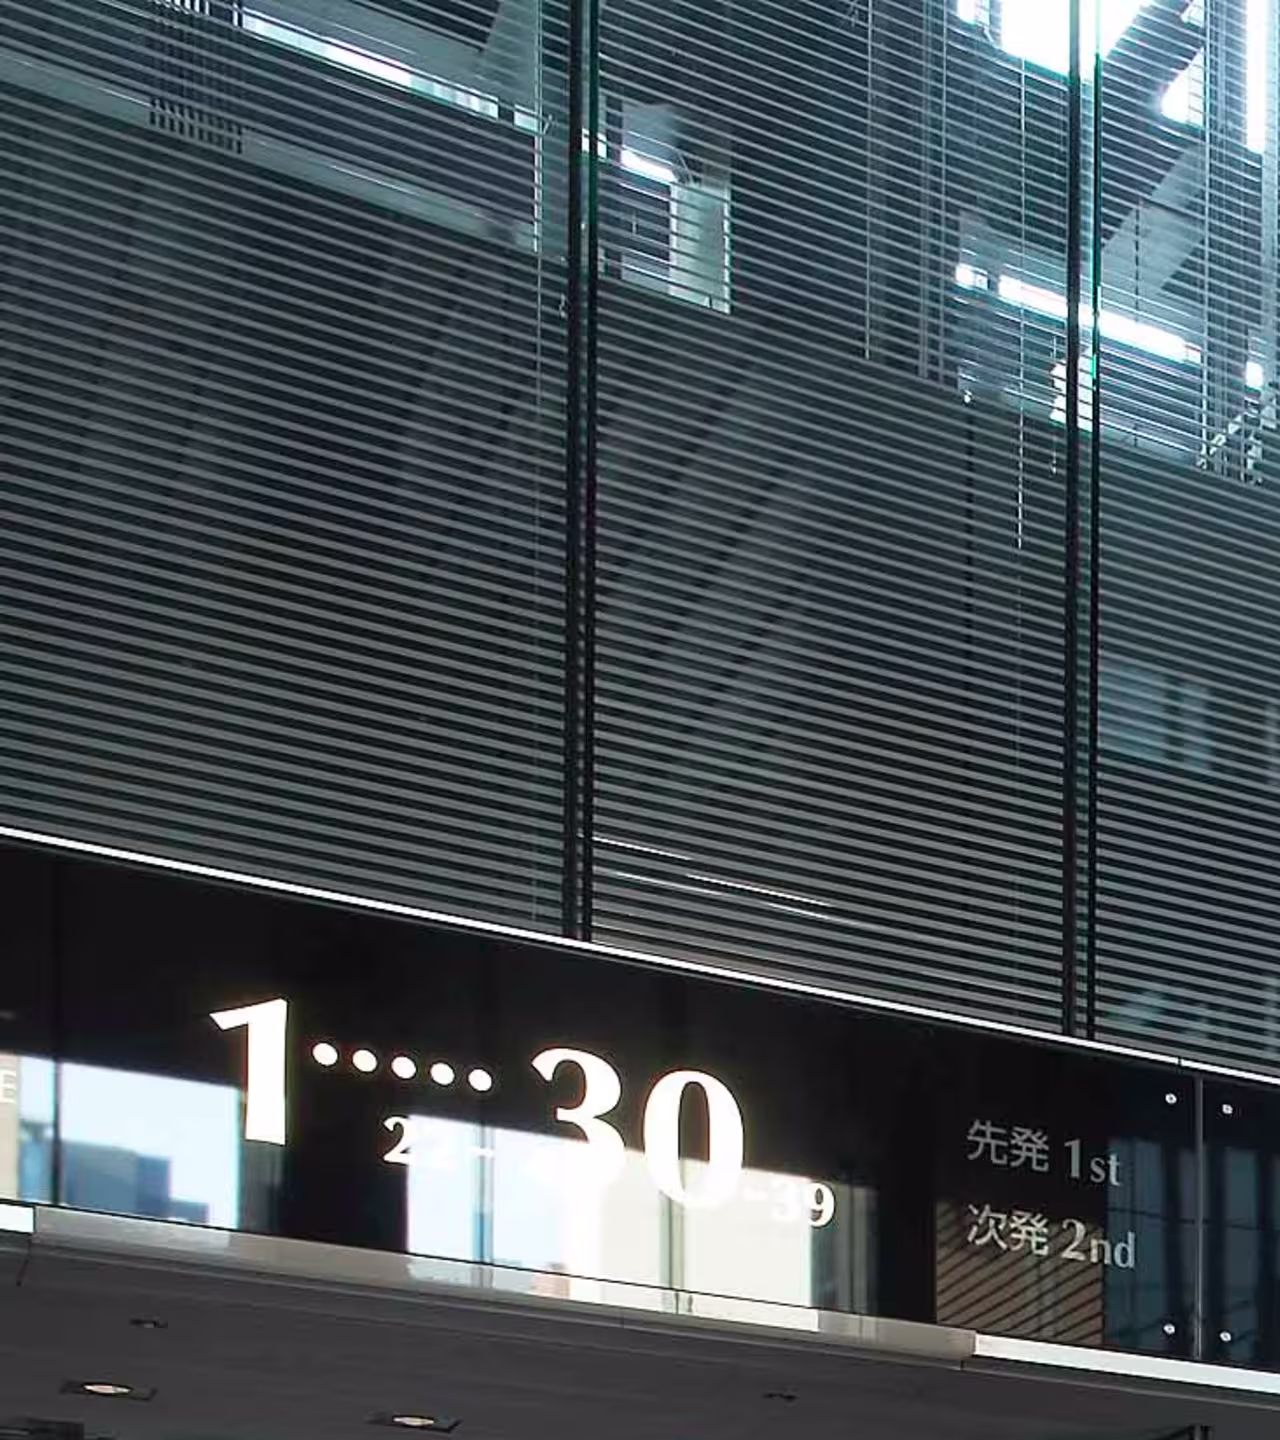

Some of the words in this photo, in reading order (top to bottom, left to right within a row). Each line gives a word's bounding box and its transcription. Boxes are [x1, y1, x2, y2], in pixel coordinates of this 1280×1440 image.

[967, 1120, 1050, 1172] 先発
[1064, 1139, 1121, 1187] 1st
[967, 1204, 1050, 1257] 次発
[1061, 1219, 1136, 1269] 2nd
